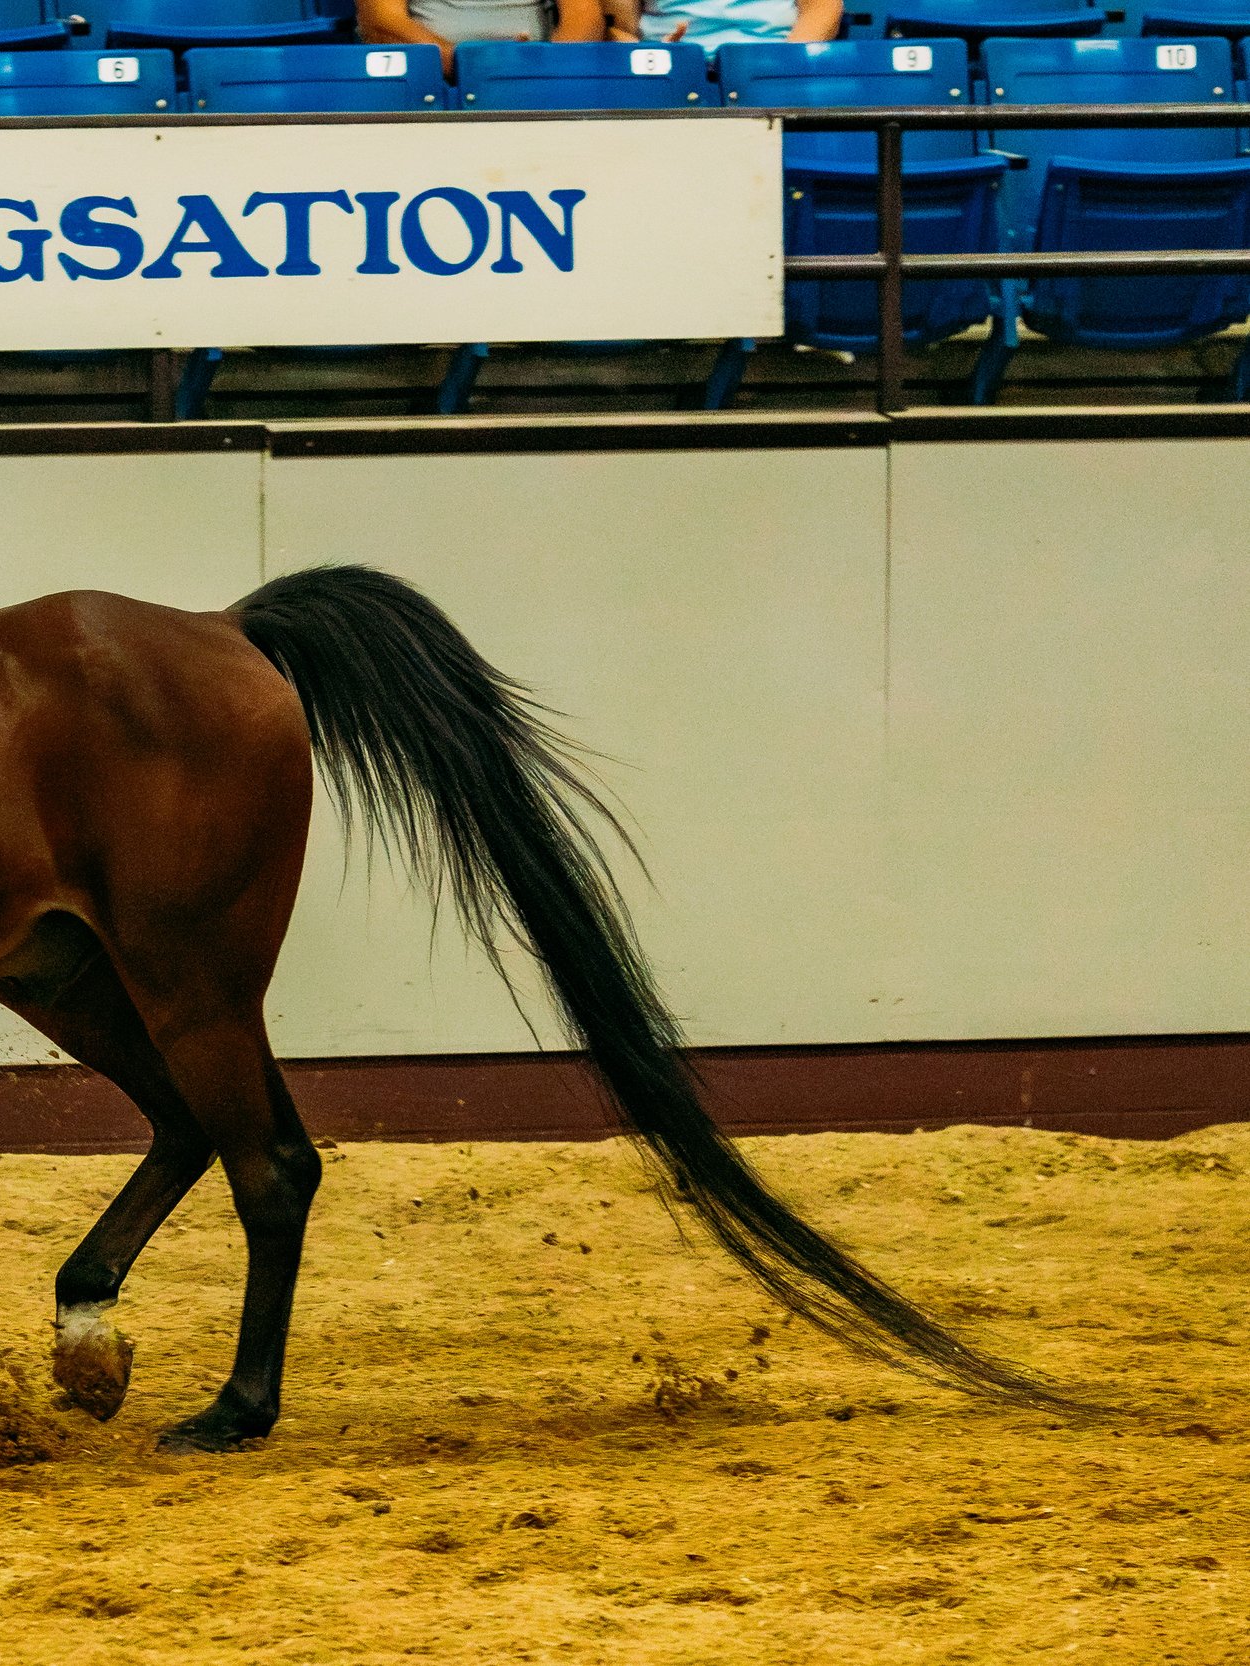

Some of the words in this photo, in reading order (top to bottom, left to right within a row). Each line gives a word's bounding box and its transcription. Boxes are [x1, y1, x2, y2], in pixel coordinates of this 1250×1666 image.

[381, 55, 393, 73] 7
[646, 52, 656, 72] 8
[906, 49, 918, 68] 9
[1166, 48, 1188, 67] 10
[112, 60, 125, 80] 6
